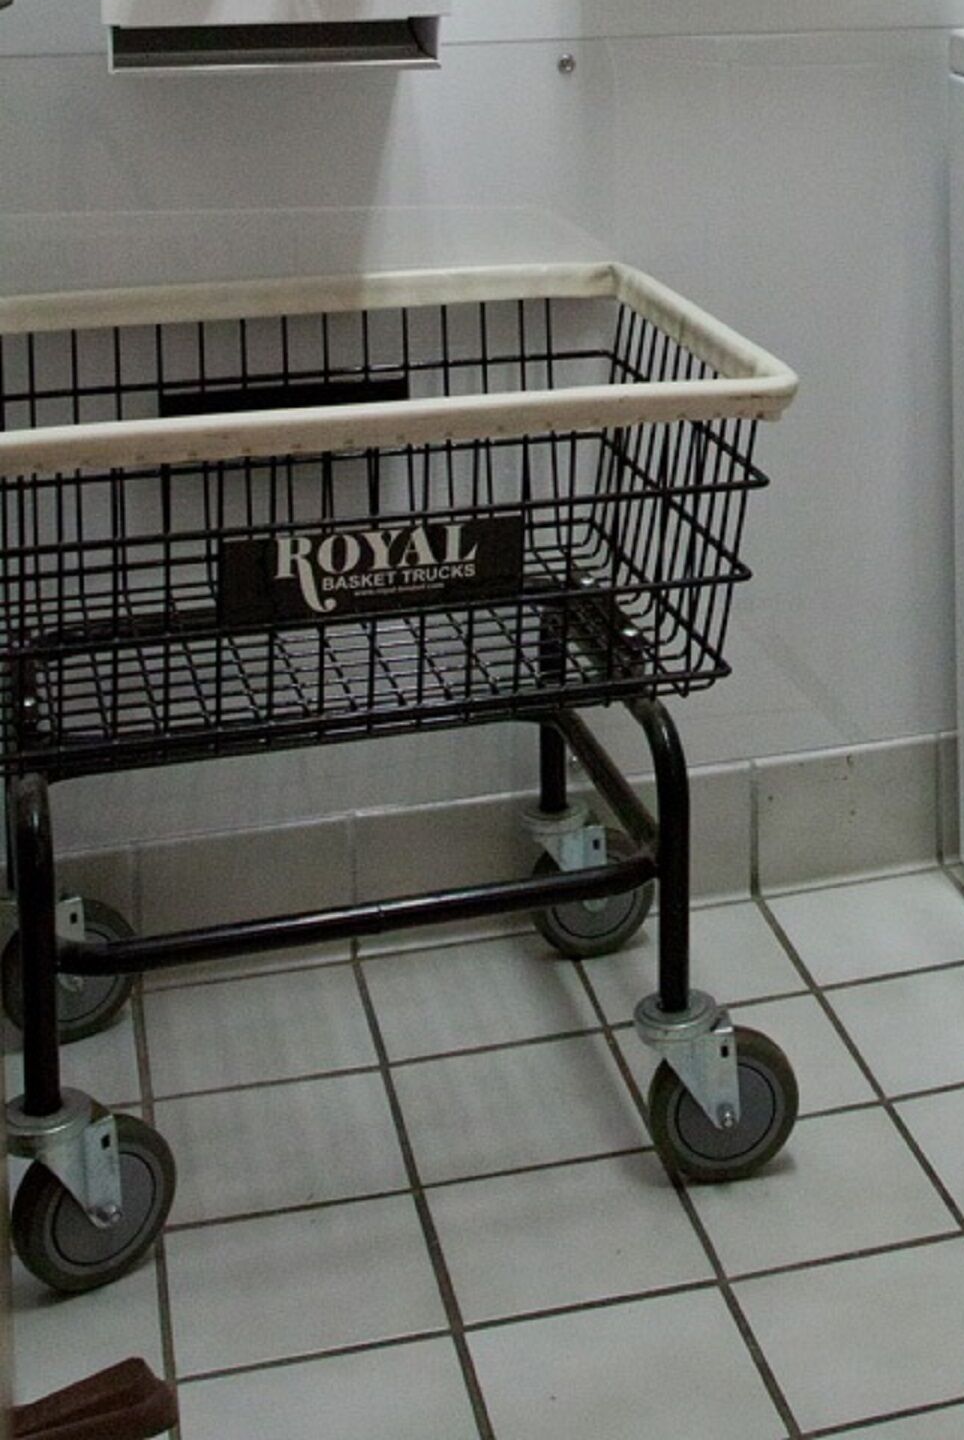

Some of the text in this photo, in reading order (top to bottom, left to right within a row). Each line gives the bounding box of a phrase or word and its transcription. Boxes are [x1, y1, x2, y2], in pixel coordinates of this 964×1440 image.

[274, 525, 478, 613] ROYAL
[322, 570, 397, 592] BASKET
[403, 564, 476, 584] TRUCKS
